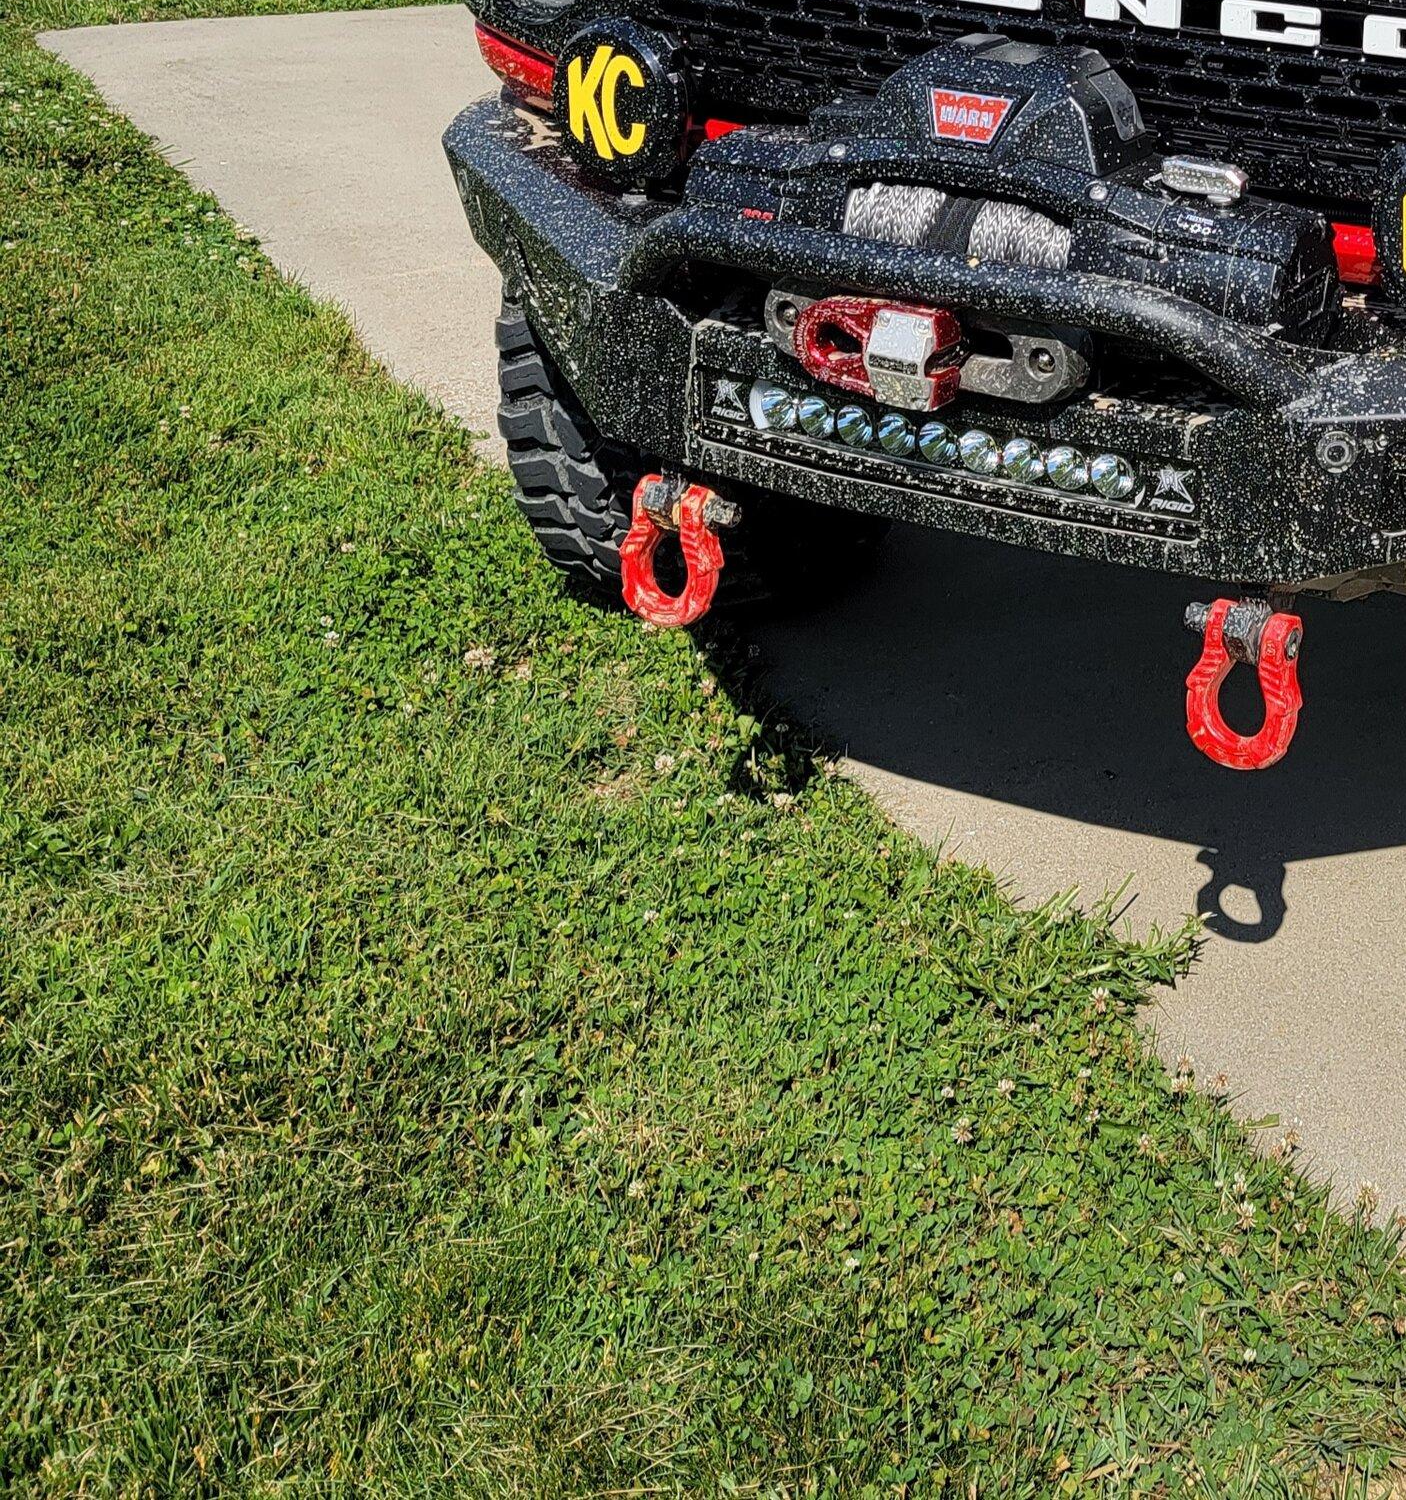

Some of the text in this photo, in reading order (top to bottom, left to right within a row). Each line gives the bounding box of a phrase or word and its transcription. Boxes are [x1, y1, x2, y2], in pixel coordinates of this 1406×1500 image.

[568, 46, 647, 161] KC
[940, 104, 994, 129] WARN
[711, 405, 747, 421] RIGID
[1149, 497, 1195, 513] RIGID
